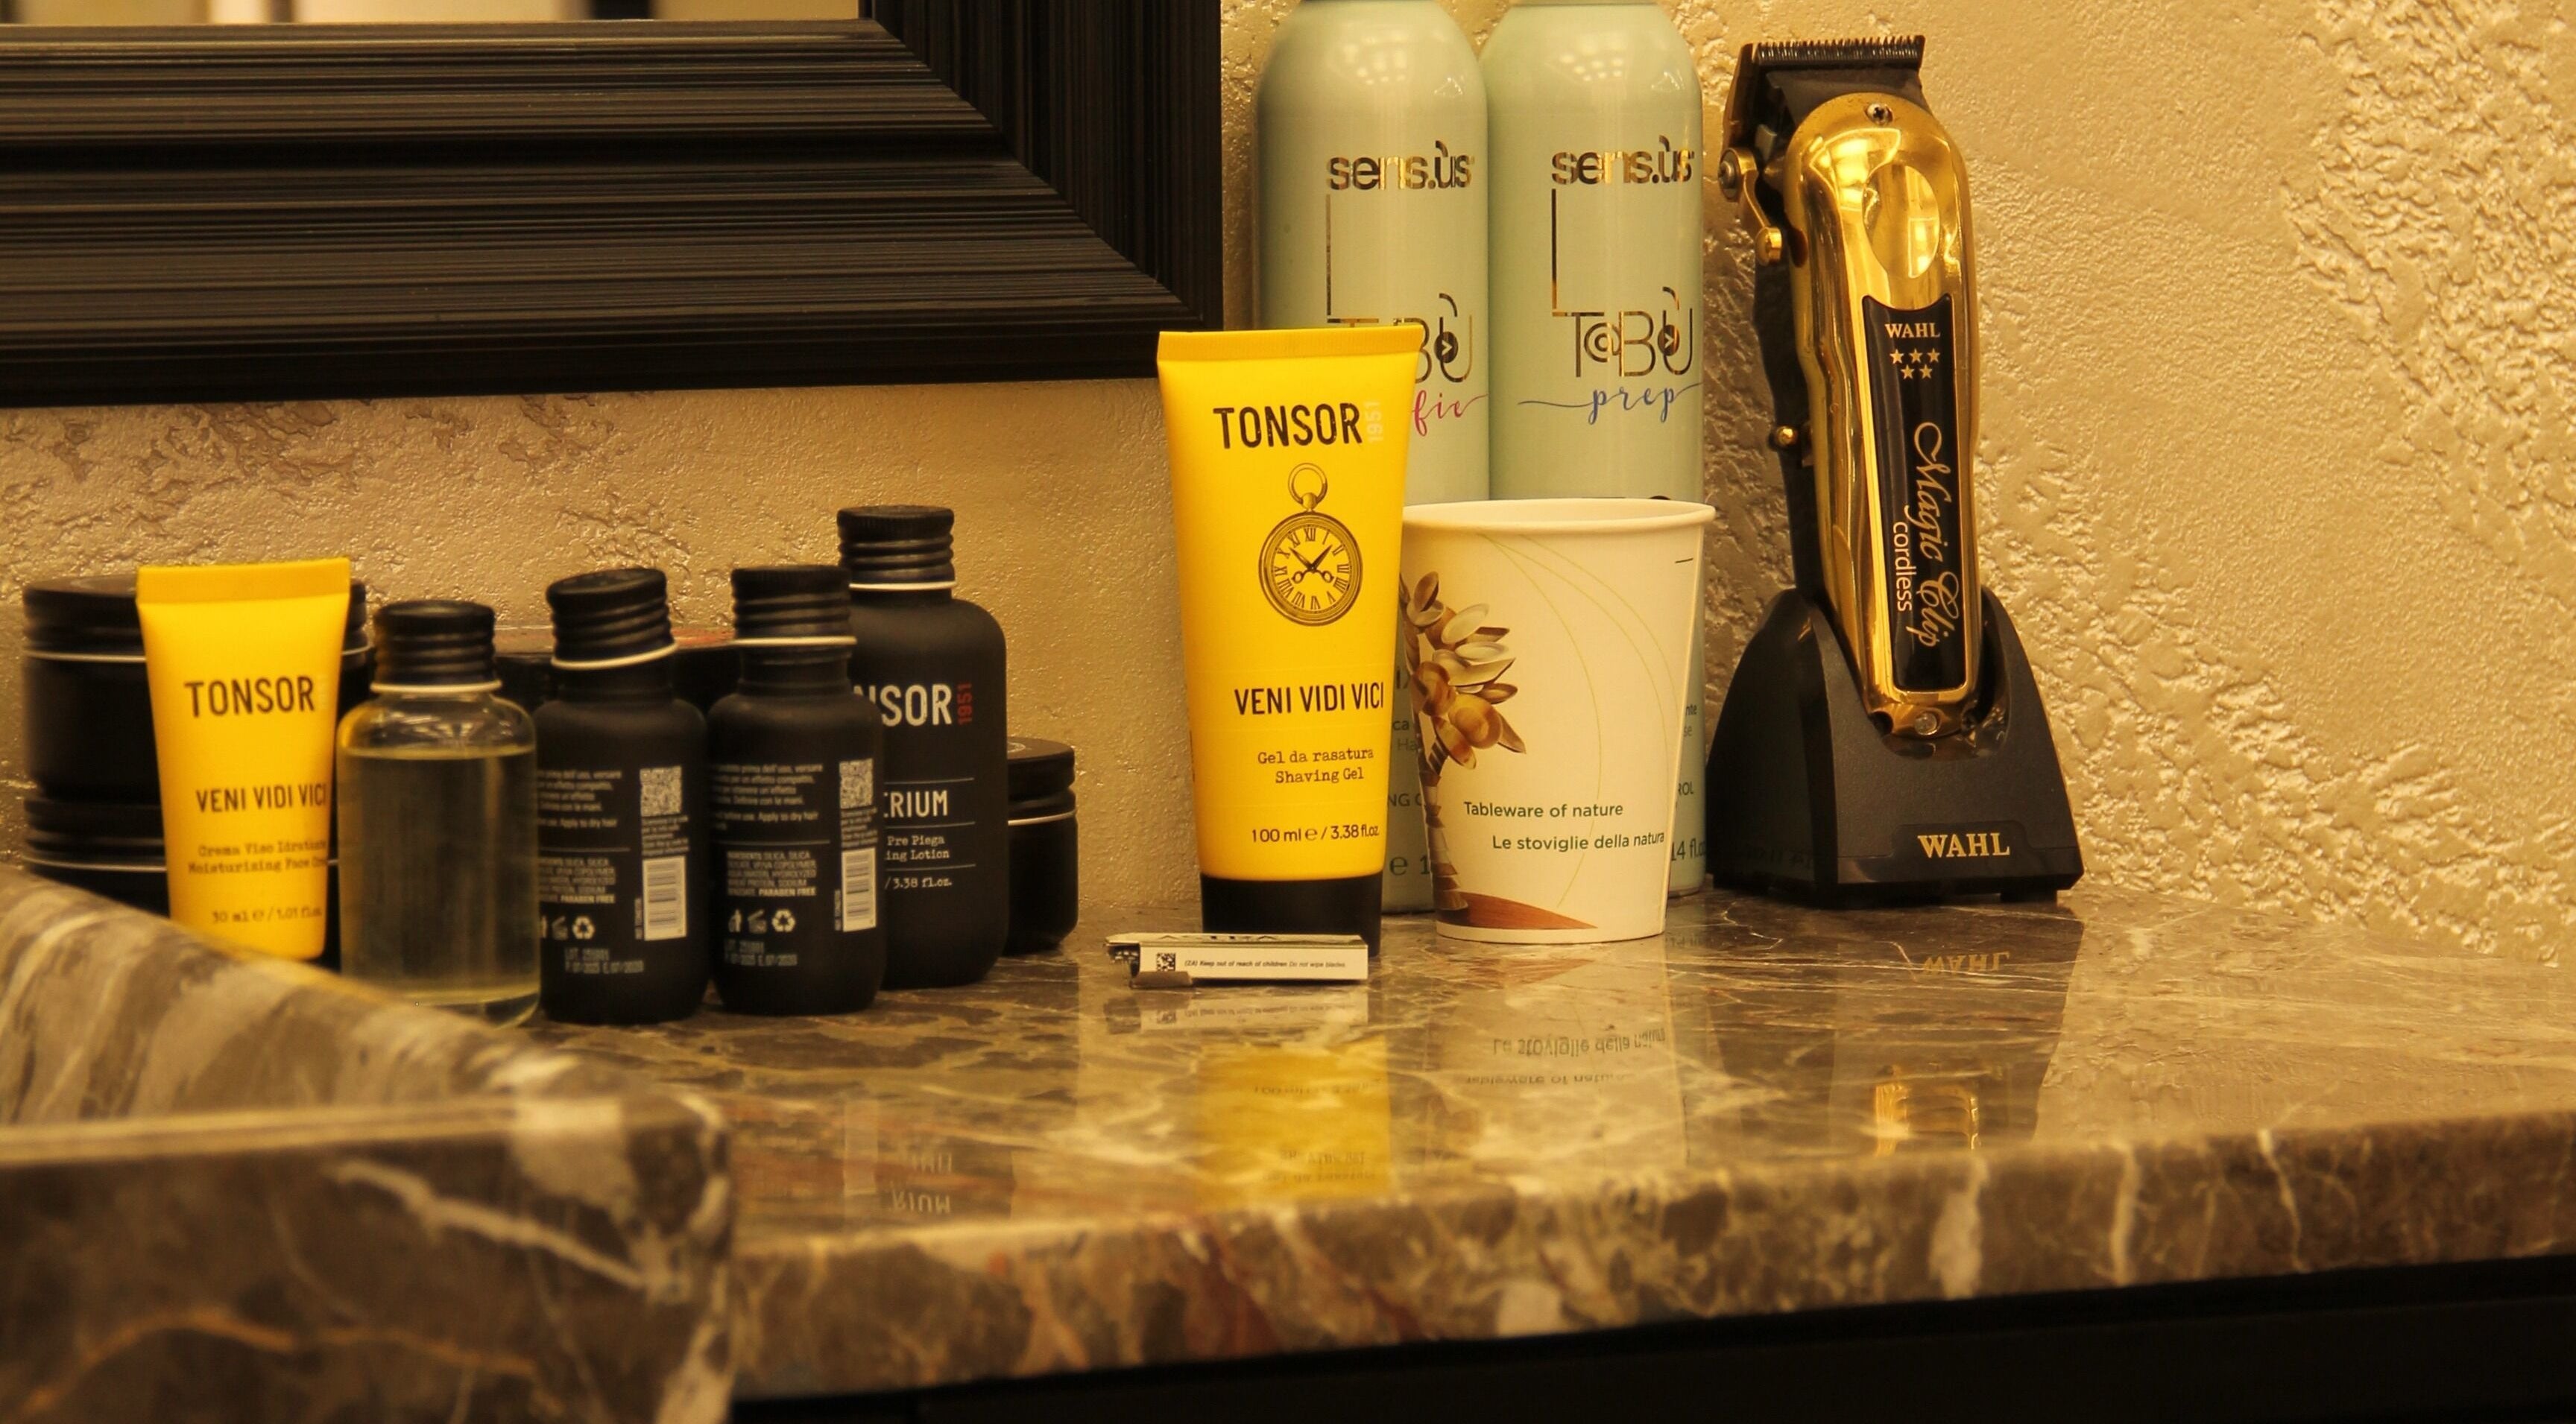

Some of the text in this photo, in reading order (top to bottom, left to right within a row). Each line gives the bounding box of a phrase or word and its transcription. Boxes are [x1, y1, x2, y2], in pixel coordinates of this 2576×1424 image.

[1885, 323, 1941, 338] WAHL
[1576, 385, 1686, 425] prep
[1213, 402, 1363, 449] TONSOR
[1904, 422, 1953, 562] Magic
[1893, 520, 1917, 613] cordless
[1906, 572, 1960, 648] Clip
[184, 675, 315, 718] TONSOR
[956, 683, 973, 725] 1951
[1234, 681, 1384, 715] VENI VIDI VICI
[1257, 747, 1374, 765] Gel da rasatura
[1275, 767, 1364, 783] Shaving Gel
[195, 783, 326, 813] VENI VIDI VICI
[1464, 801, 1623, 817] Tableware of nature
[887, 834, 945, 848] Pre Piega
[1251, 829, 1280, 843] 100
[1284, 828, 1301, 842] ml
[1330, 824, 1360, 839] 3.38
[1491, 830, 1665, 853] Le stoviglie della natura
[1917, 832, 2010, 858] WAHL
[910, 848, 950, 860] Lotion
[758, 887, 796, 897] PARABEN
[797, 886, 817, 896] FREE
[893, 877, 918, 889] 3.38
[1199, 960, 1215, 968] Keep
[1262, 960, 1288, 968] children
